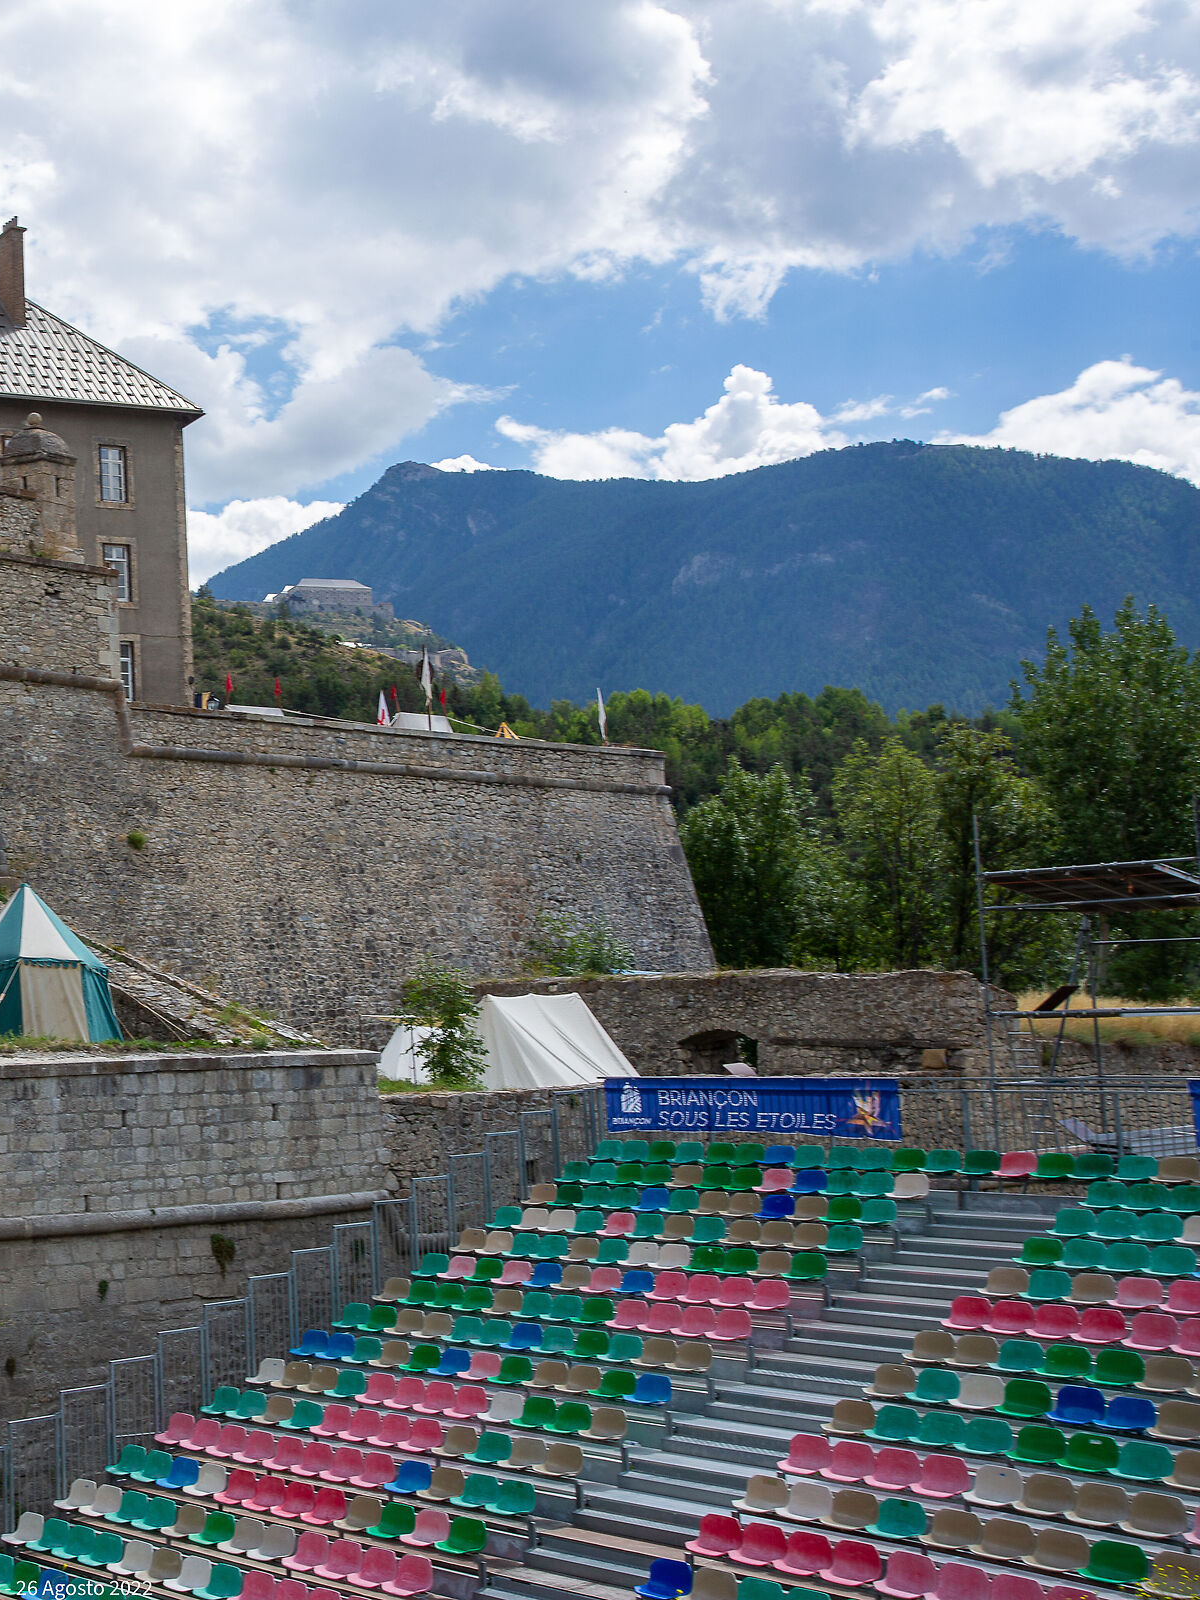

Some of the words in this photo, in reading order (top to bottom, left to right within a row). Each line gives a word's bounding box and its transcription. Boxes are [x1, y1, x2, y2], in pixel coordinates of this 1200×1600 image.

[657, 1089, 758, 1109] BRIANÇON
[657, 1110, 709, 1127] SOUS
[714, 1111, 750, 1128] LES
[755, 1112, 838, 1130] ETOILES
